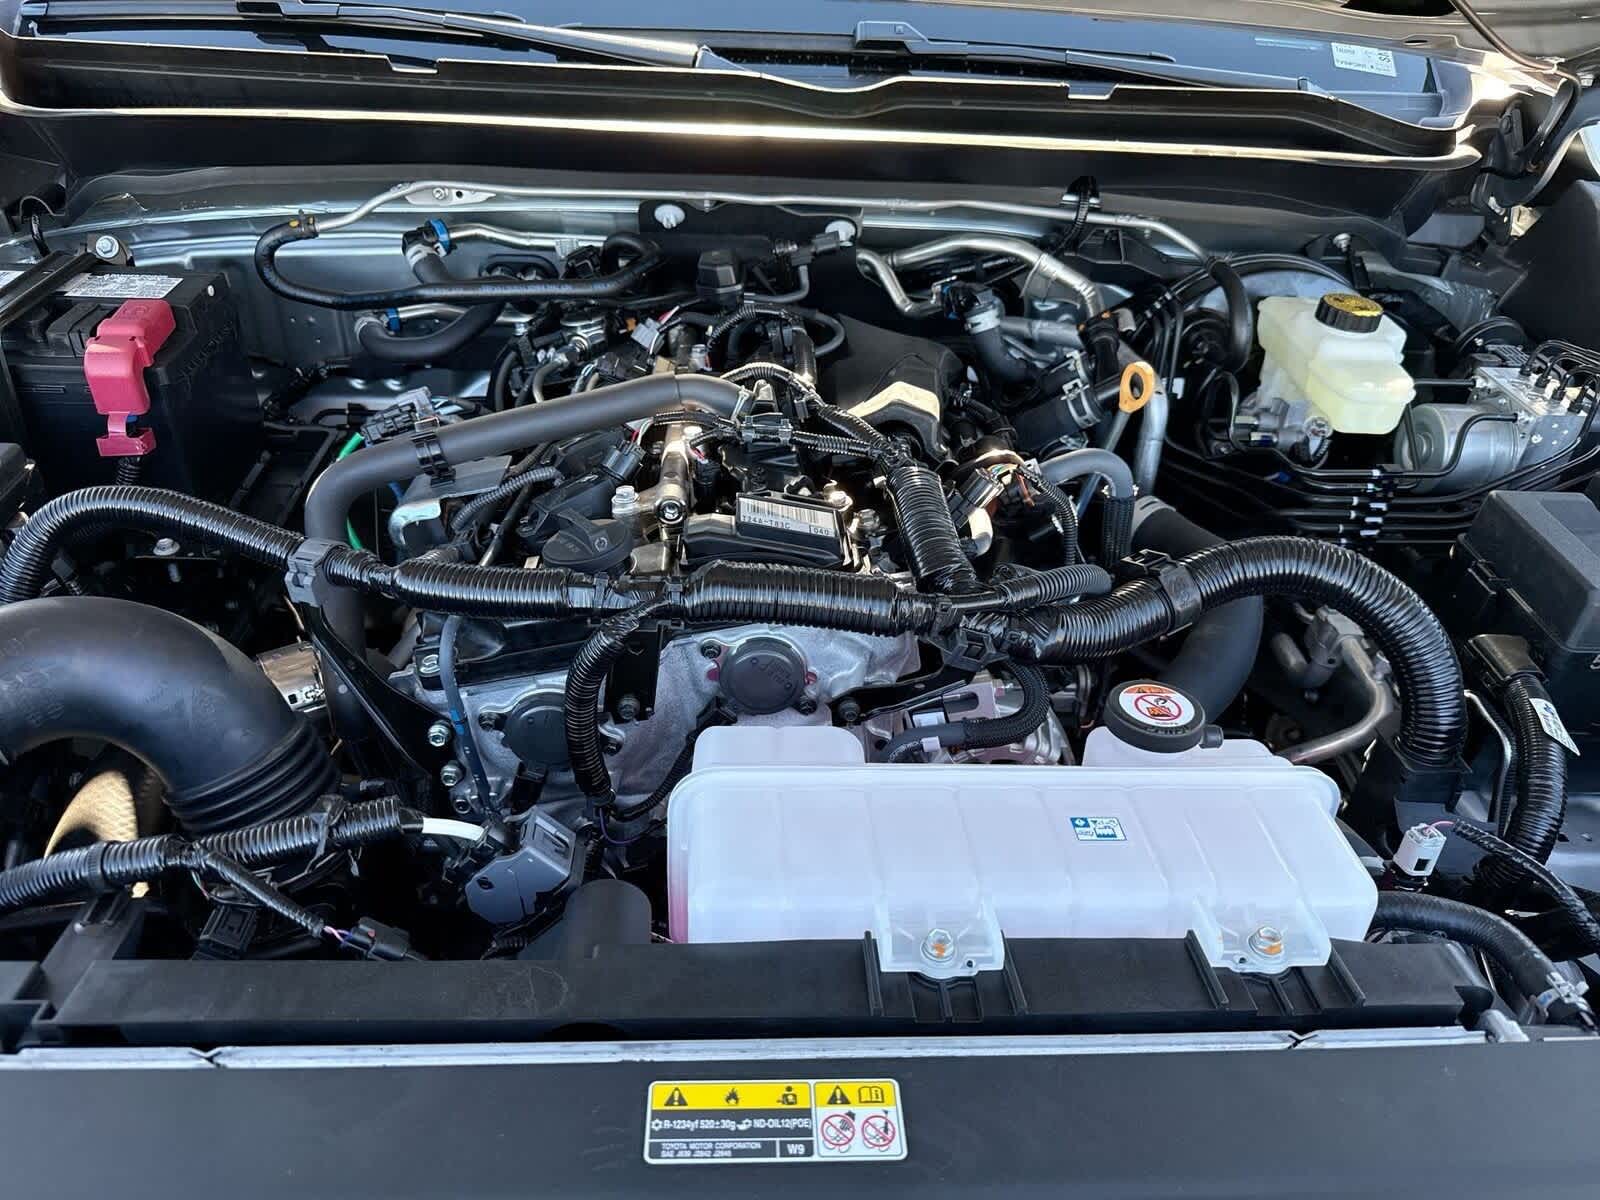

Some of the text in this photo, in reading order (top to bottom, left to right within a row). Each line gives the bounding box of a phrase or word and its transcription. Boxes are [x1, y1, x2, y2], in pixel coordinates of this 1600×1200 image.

[661, 1141, 762, 1150] TOYOTA MOTOR CORPORATION
[786, 1143, 806, 1156] W9
